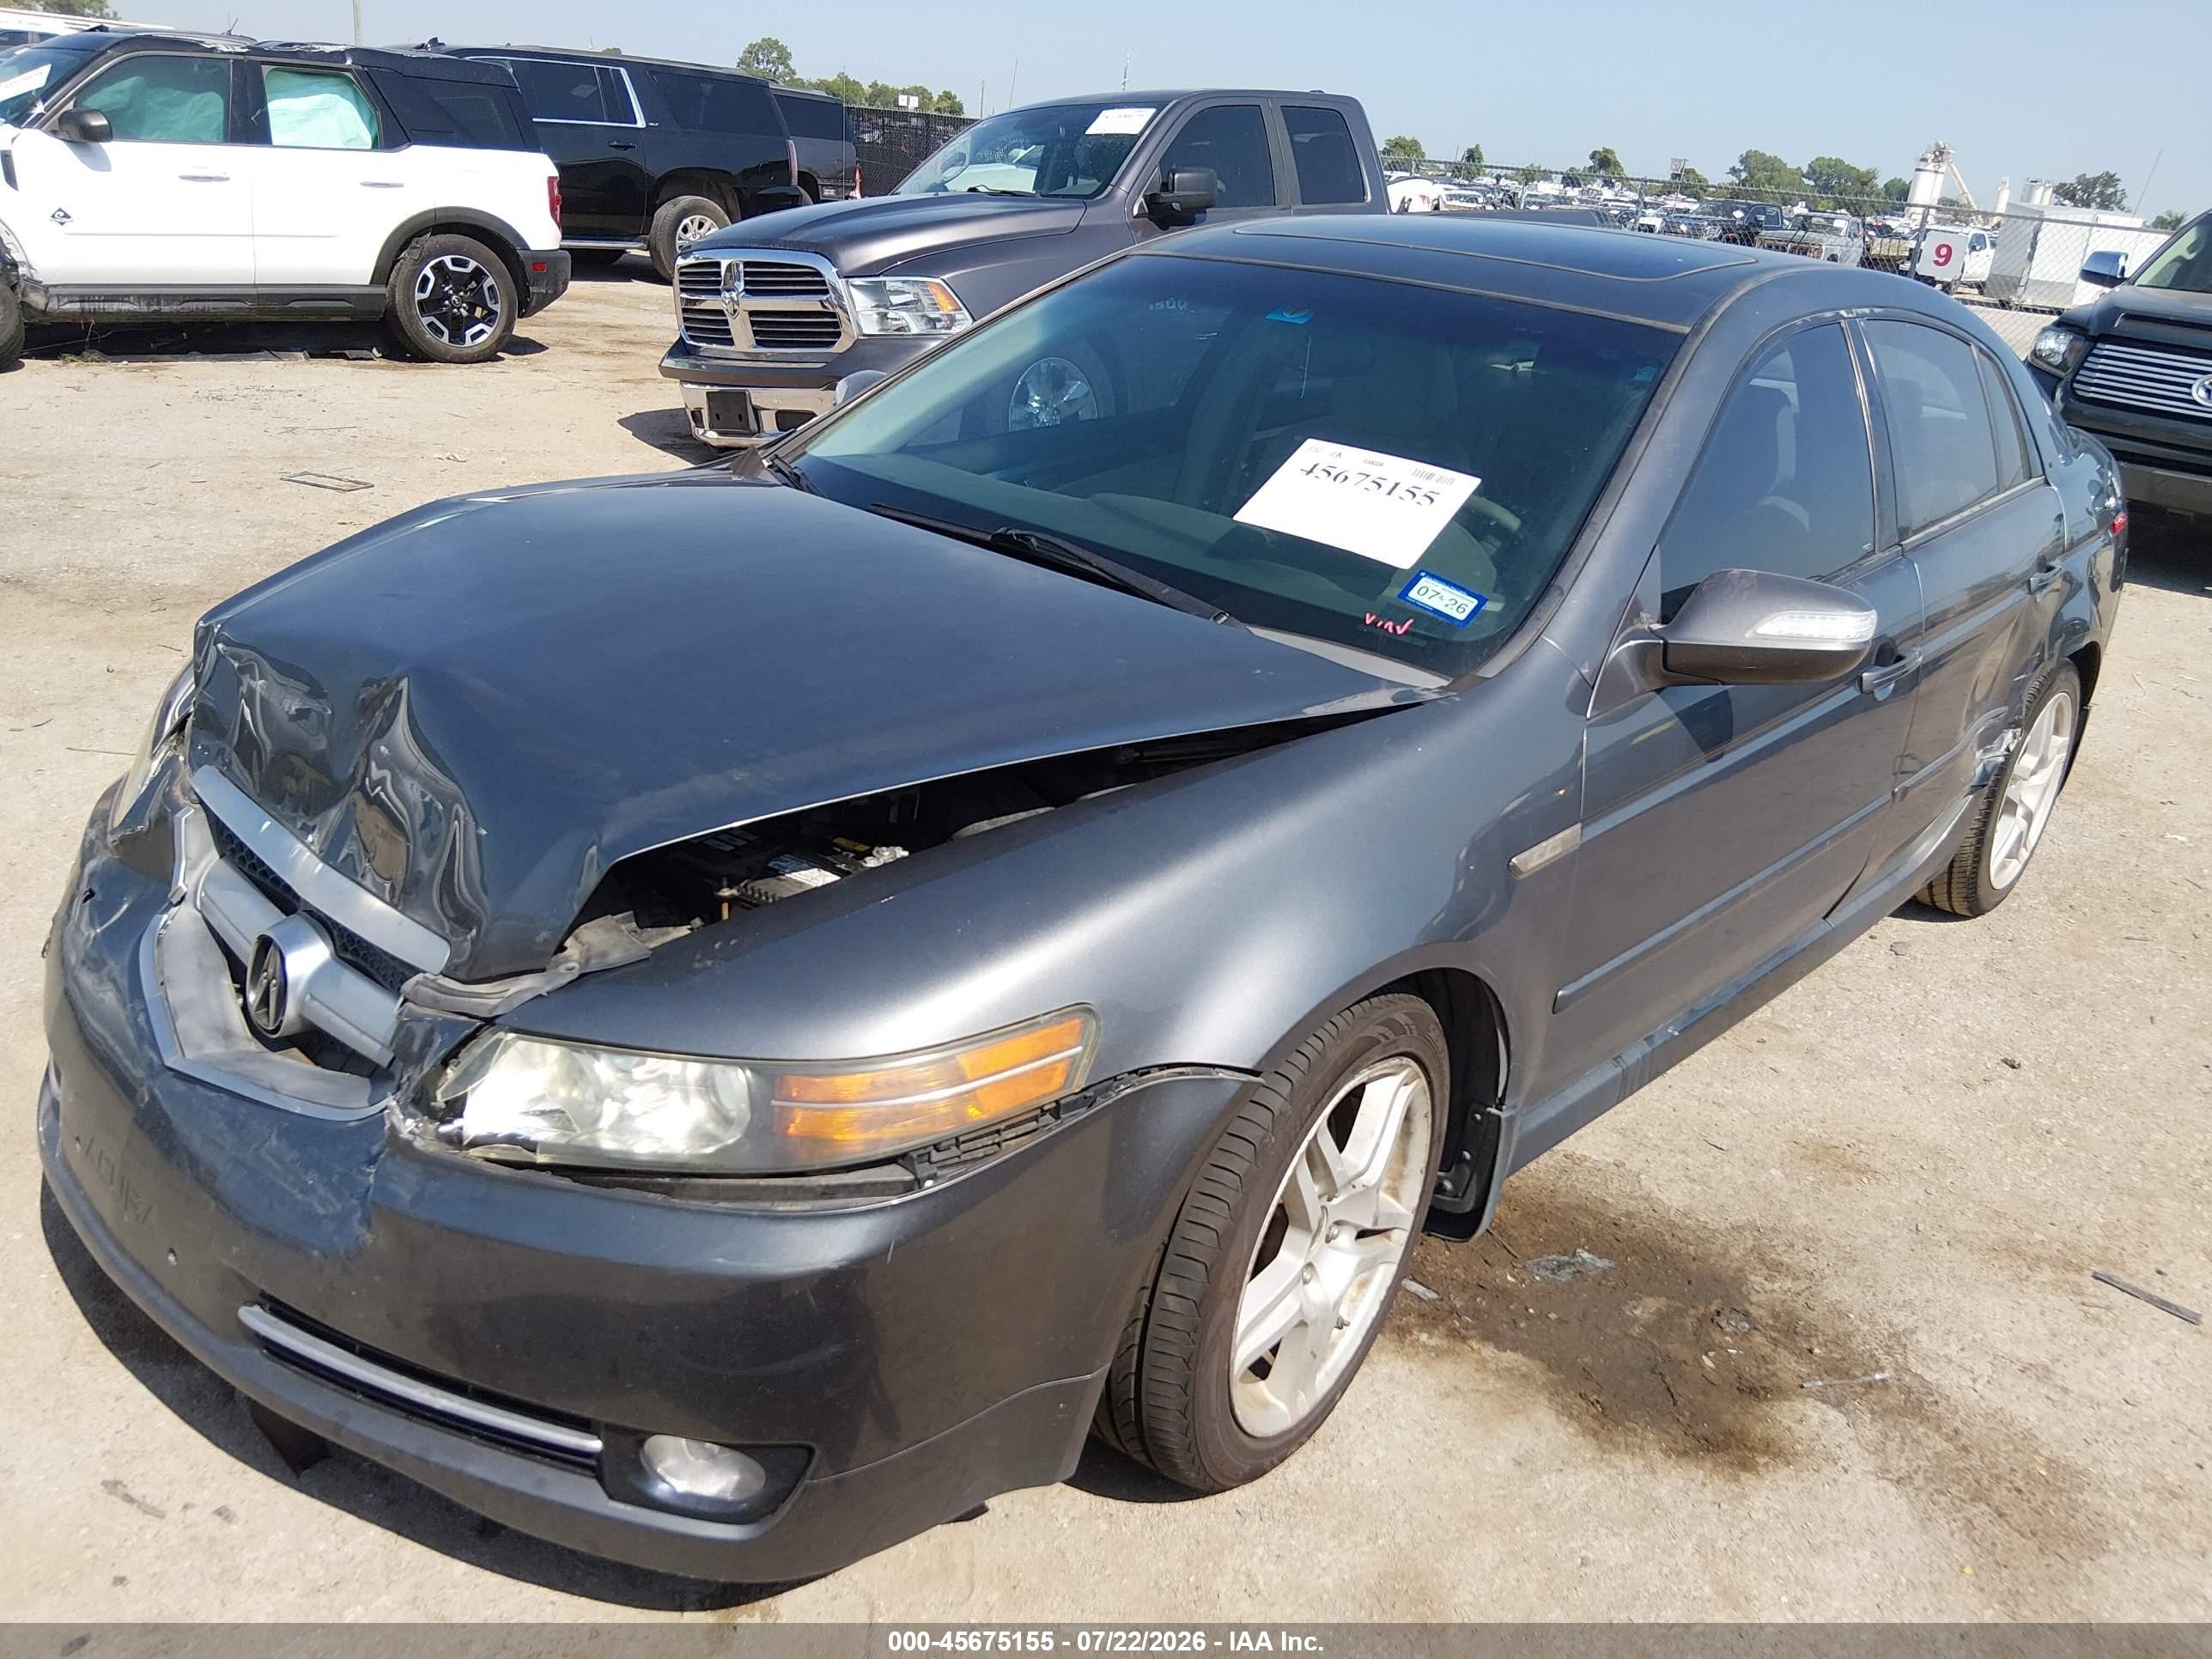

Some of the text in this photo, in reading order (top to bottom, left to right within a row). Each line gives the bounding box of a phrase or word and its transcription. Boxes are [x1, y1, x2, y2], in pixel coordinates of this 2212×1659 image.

[1933, 243, 1953, 266] 9
[1300, 462, 1440, 506] 45675155
[1417, 586, 1441, 599] 07
[1444, 598, 1468, 614] 26
